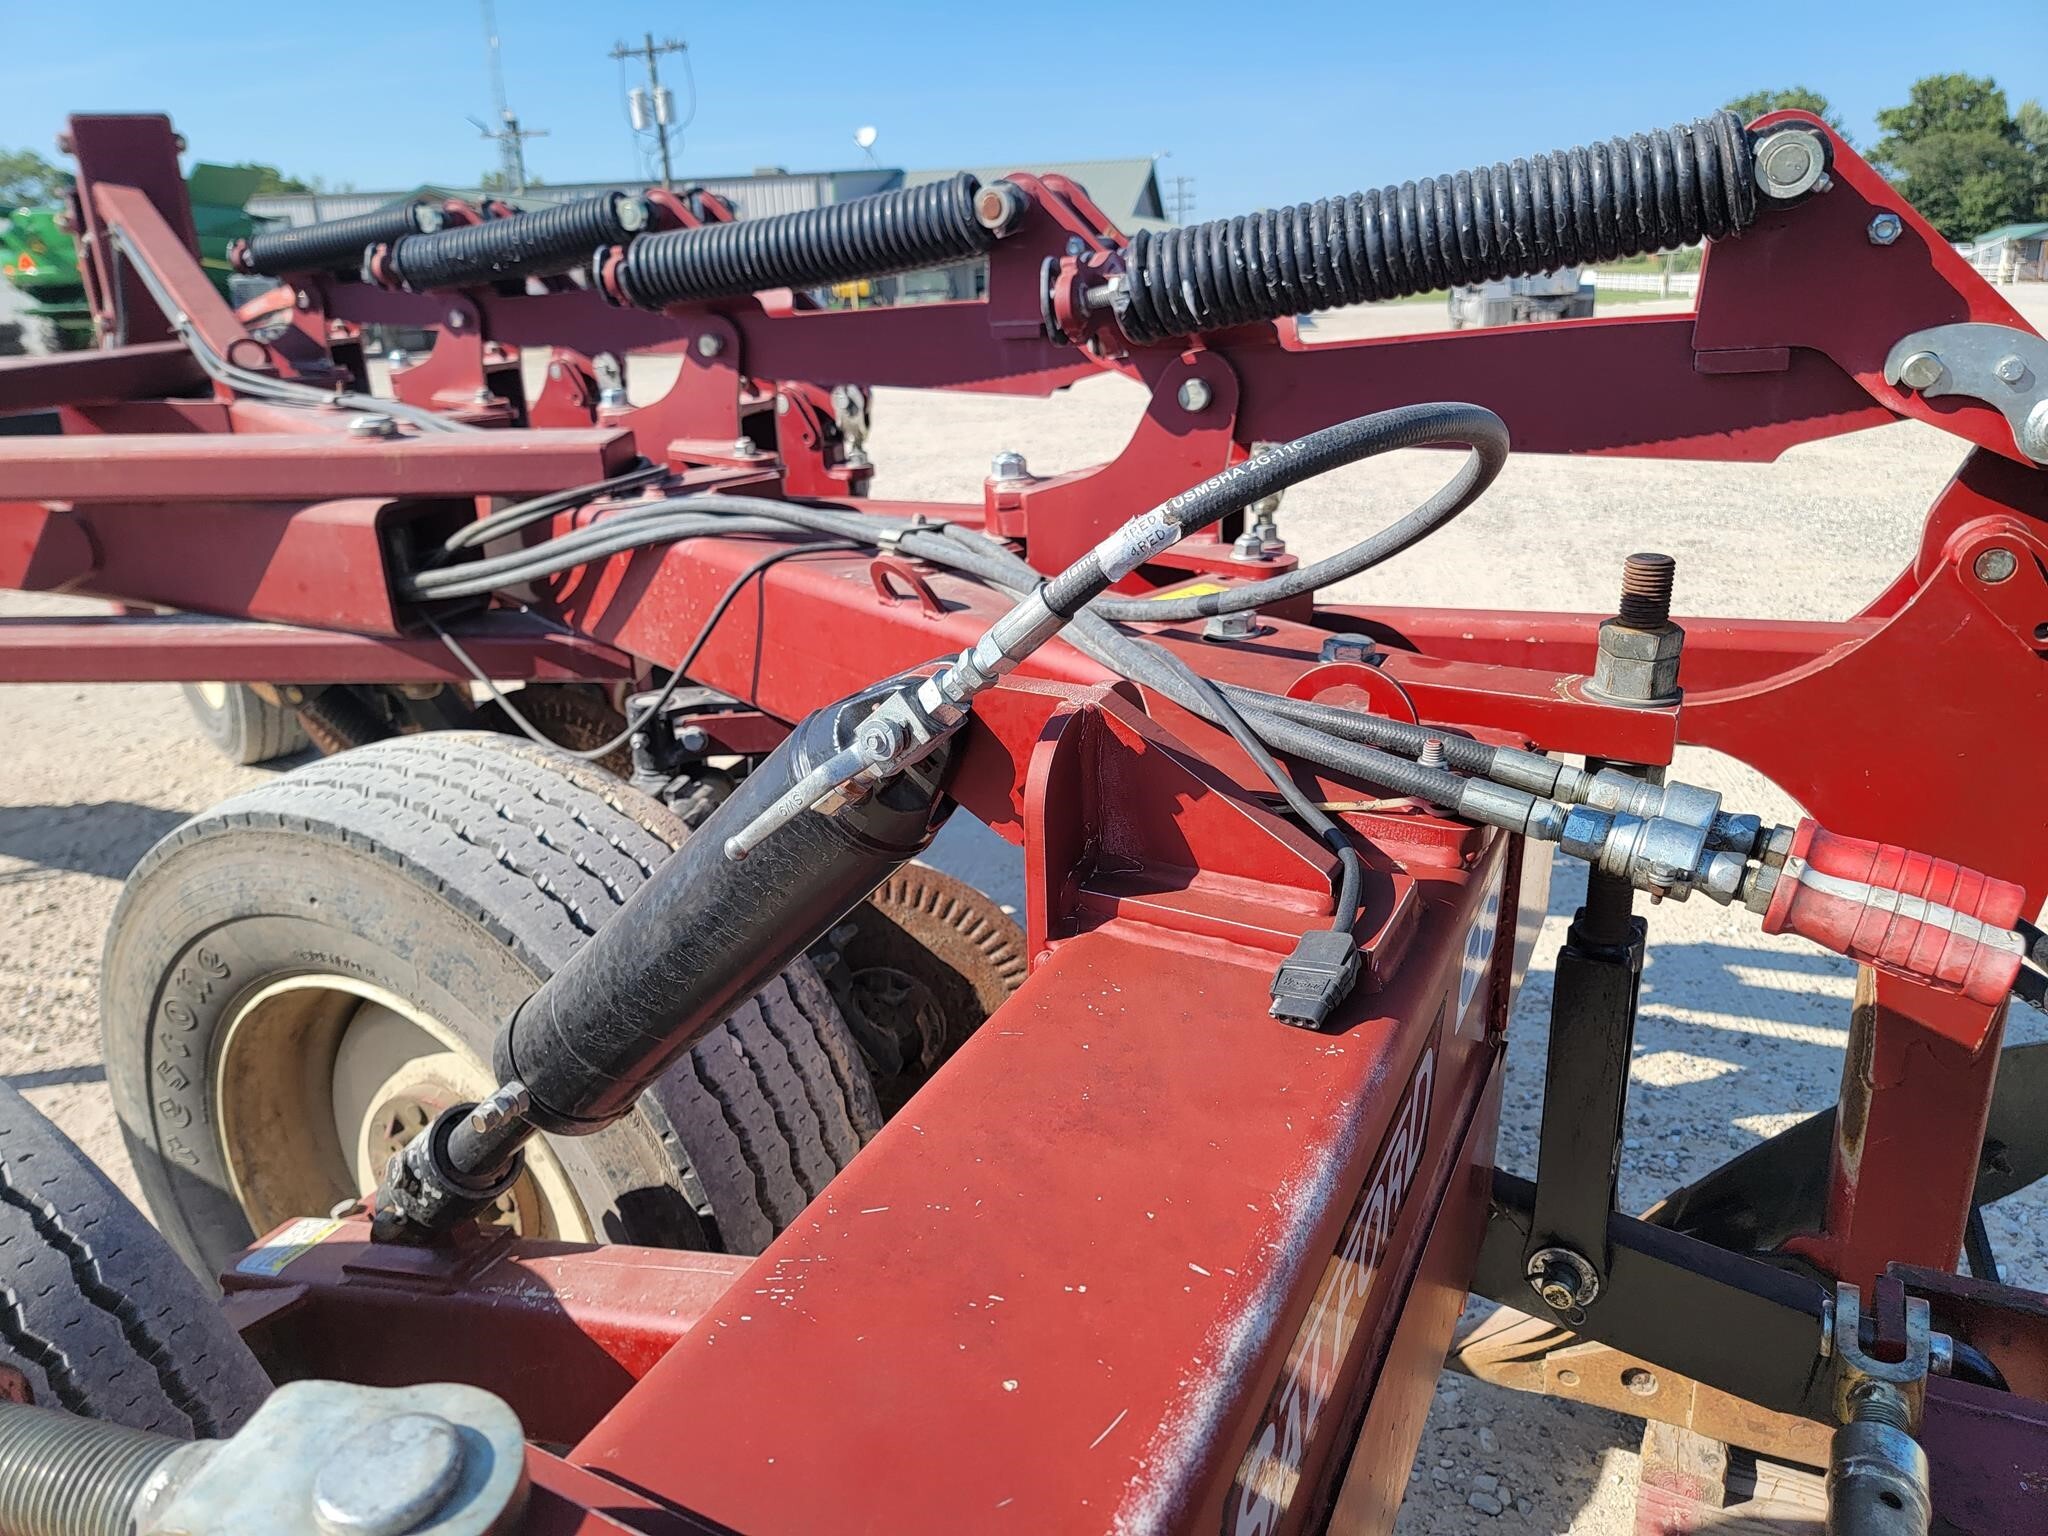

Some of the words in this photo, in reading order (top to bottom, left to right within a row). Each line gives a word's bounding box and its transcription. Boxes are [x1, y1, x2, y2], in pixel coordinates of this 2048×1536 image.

[1060, 551, 1100, 586] Flame
[1172, 468, 1246, 509] USMSHA
[1246, 439, 1307, 472] 2G-11C
